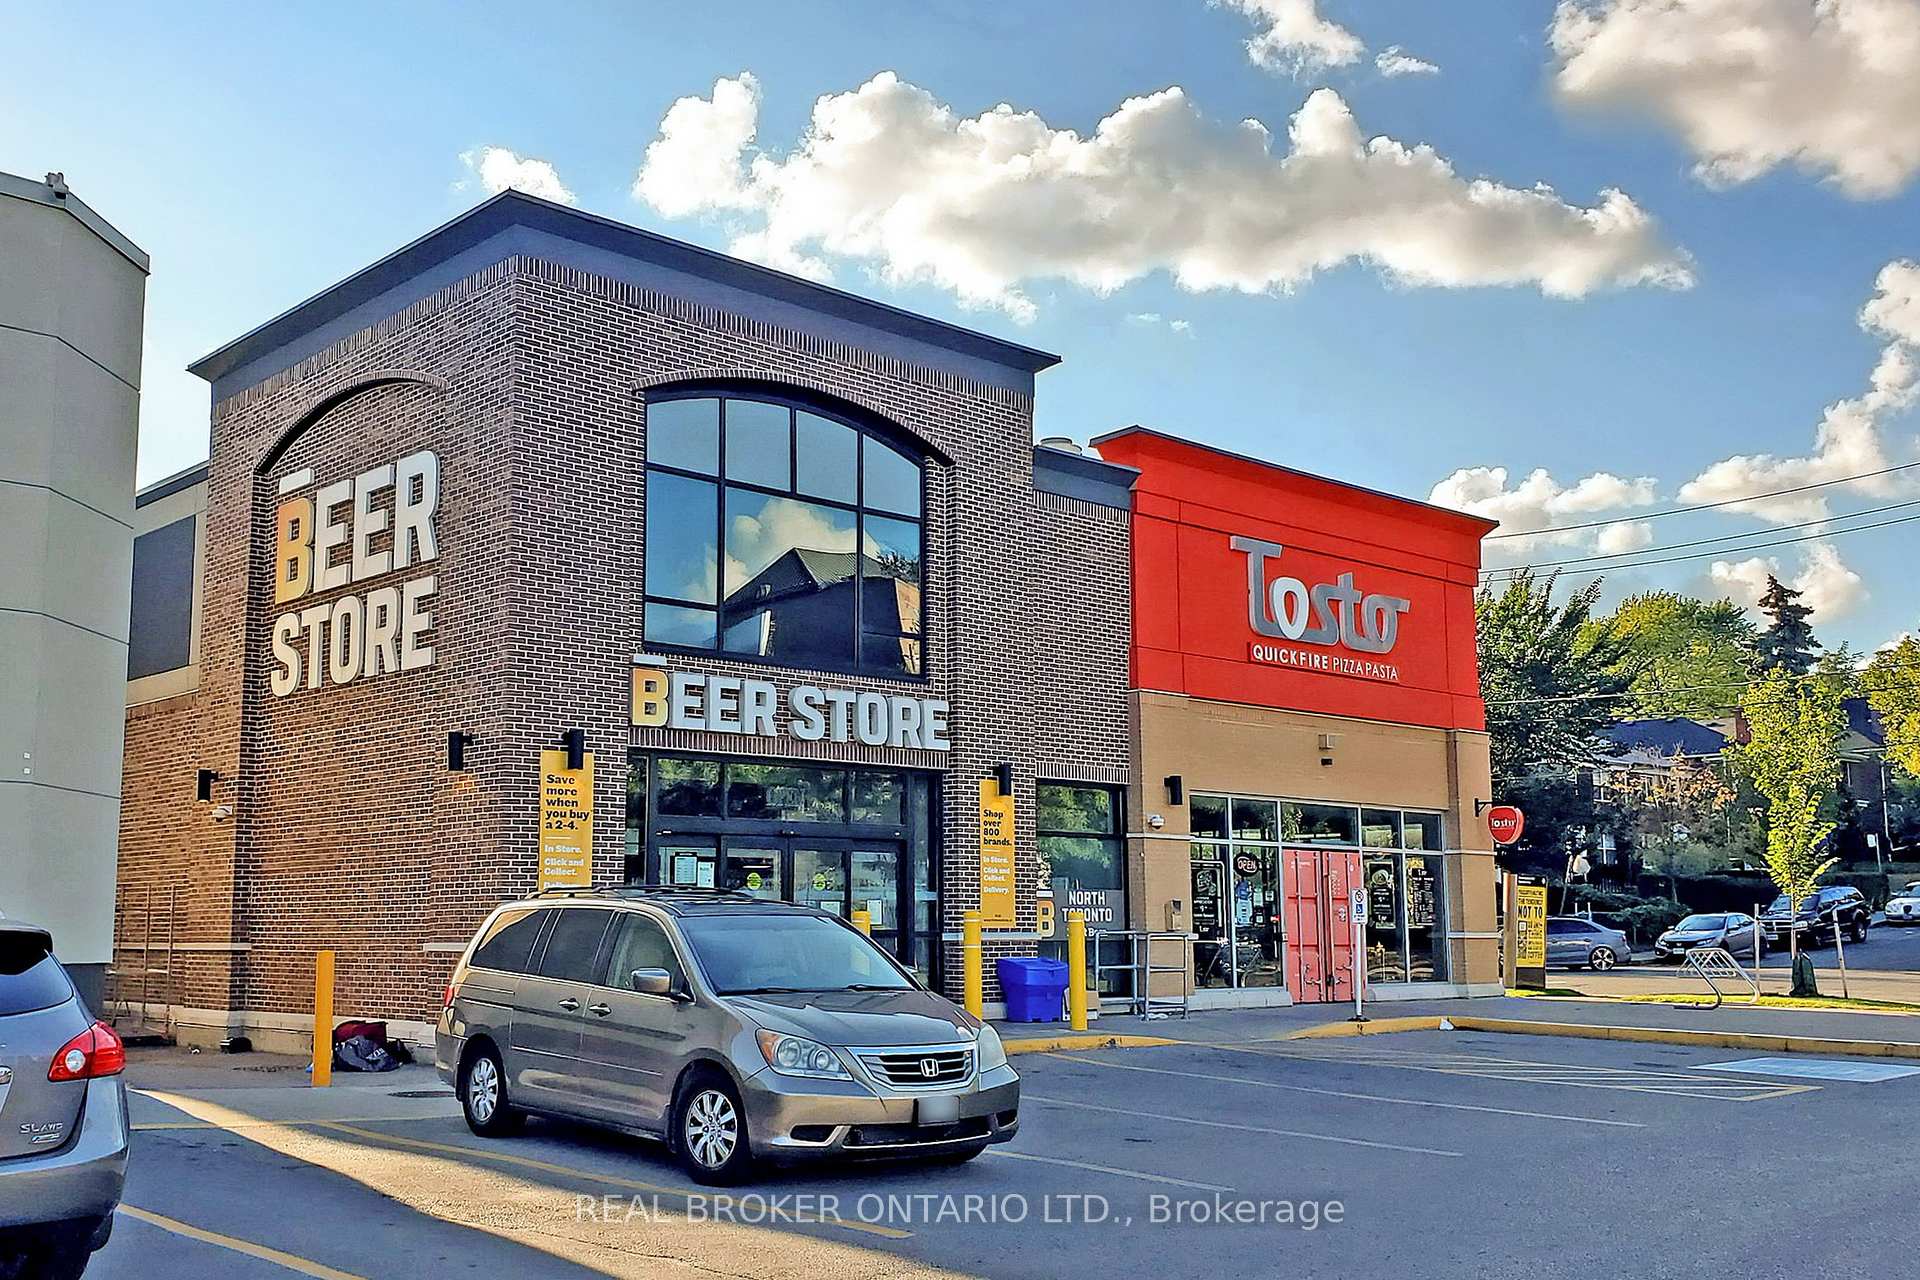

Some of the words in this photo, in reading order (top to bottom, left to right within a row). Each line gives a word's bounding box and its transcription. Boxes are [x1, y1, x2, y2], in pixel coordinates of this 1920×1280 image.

[275, 450, 440, 605] BEER
[1230, 535, 1411, 654] Tosto
[271, 576, 438, 697] STORE
[1253, 644, 1329, 670] QUICKFIRE
[1333, 657, 1363, 676] PIZZA
[1365, 662, 1399, 681] PASTA
[631, 667, 778, 737] BEER
[788, 685, 950, 751] STORE
[546, 774, 576, 785] Save
[546, 787, 578, 796] more
[545, 797, 579, 808] when
[545, 810, 567, 820] you
[569, 808, 590, 822] buy
[983, 809, 1004, 819] Shop
[545, 821, 553, 830] a
[555, 820, 579, 831] 2-4.
[983, 820, 1002, 828] over
[983, 829, 1000, 837] 800
[983, 837, 1013, 847] brands.
[544, 844, 554, 854] In
[554, 844, 583, 854] Store.
[1237, 859, 1257, 870] OPEN
[1068, 891, 1106, 906] NORTH
[1518, 906, 1531, 919] NOT
[1534, 906, 1543, 919] TO
